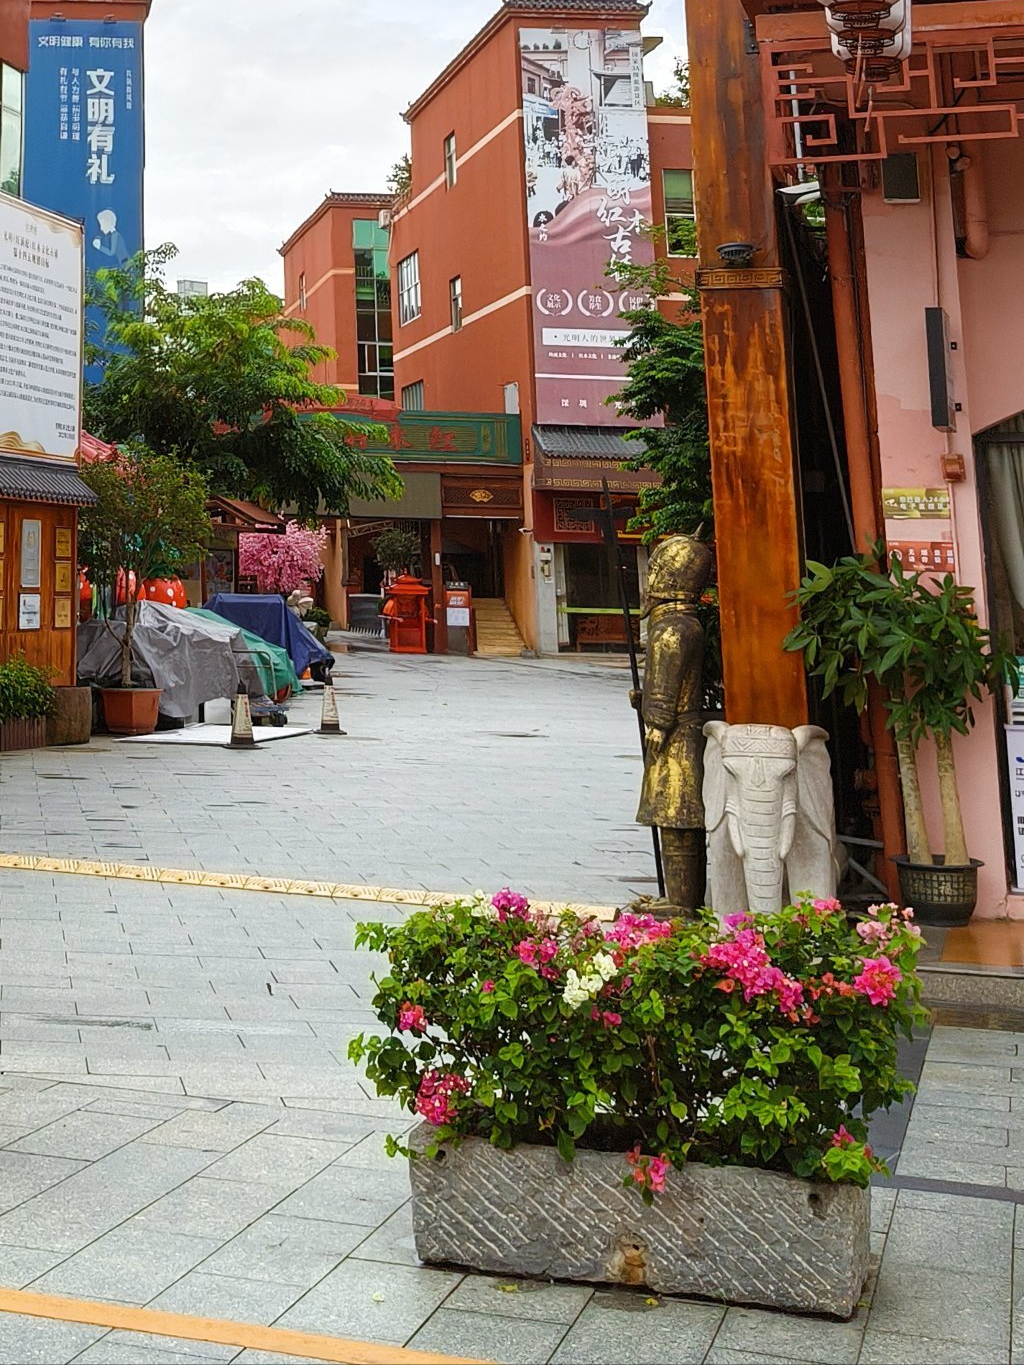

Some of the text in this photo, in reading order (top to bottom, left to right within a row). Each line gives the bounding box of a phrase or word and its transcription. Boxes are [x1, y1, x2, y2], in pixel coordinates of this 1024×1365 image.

[37, 35, 134, 49] 文明健康 有你有我
[85, 68, 116, 185] 文明有礼
